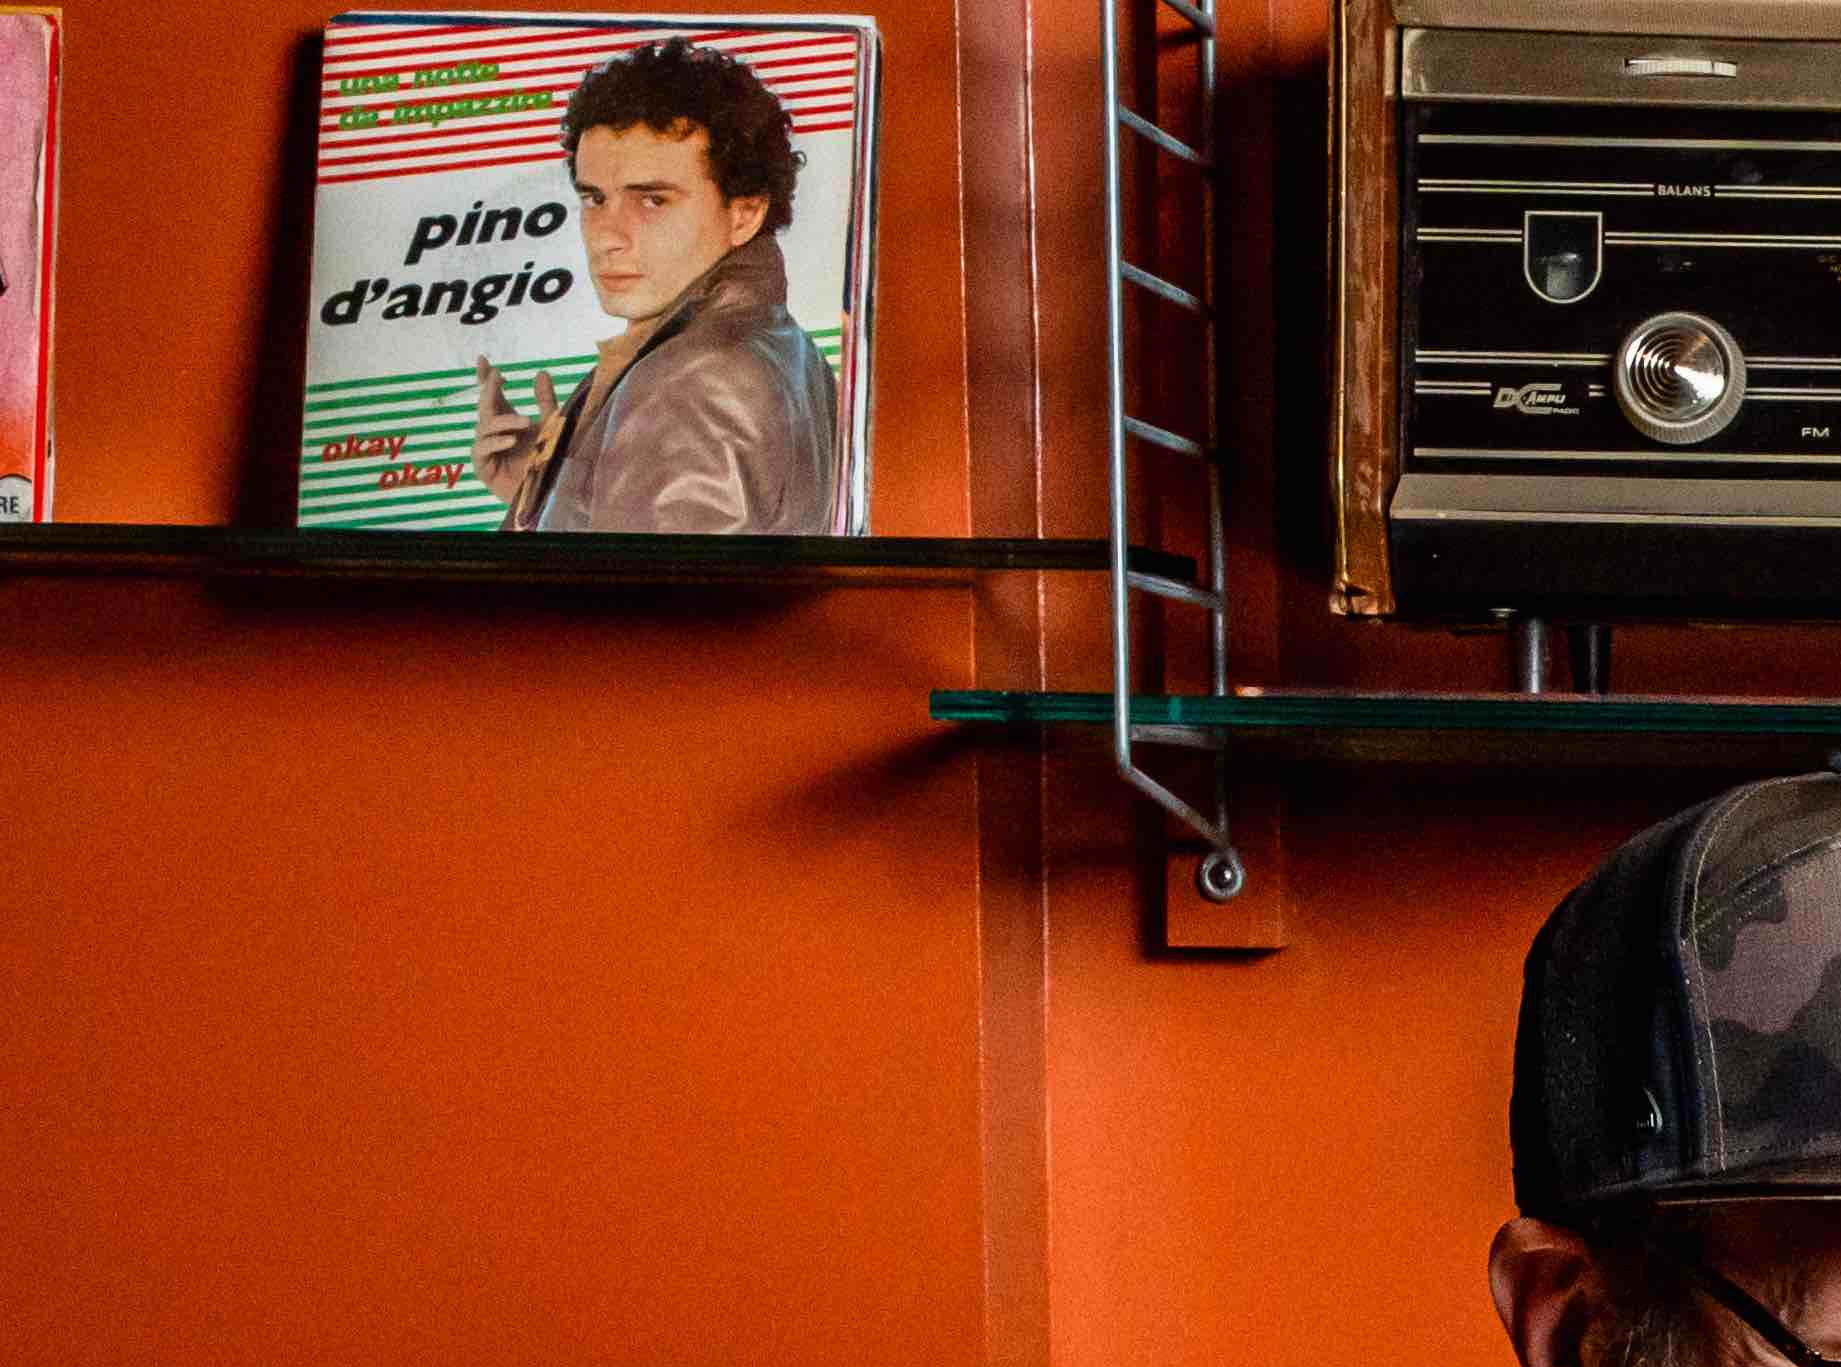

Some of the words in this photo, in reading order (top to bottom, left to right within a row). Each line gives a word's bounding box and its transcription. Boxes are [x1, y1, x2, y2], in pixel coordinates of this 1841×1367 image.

[1657, 184, 1712, 197] BALANS
[403, 200, 568, 266] pino
[1801, 427, 1830, 438] FM
[322, 433, 408, 463] okay
[379, 463, 465, 490] okay
